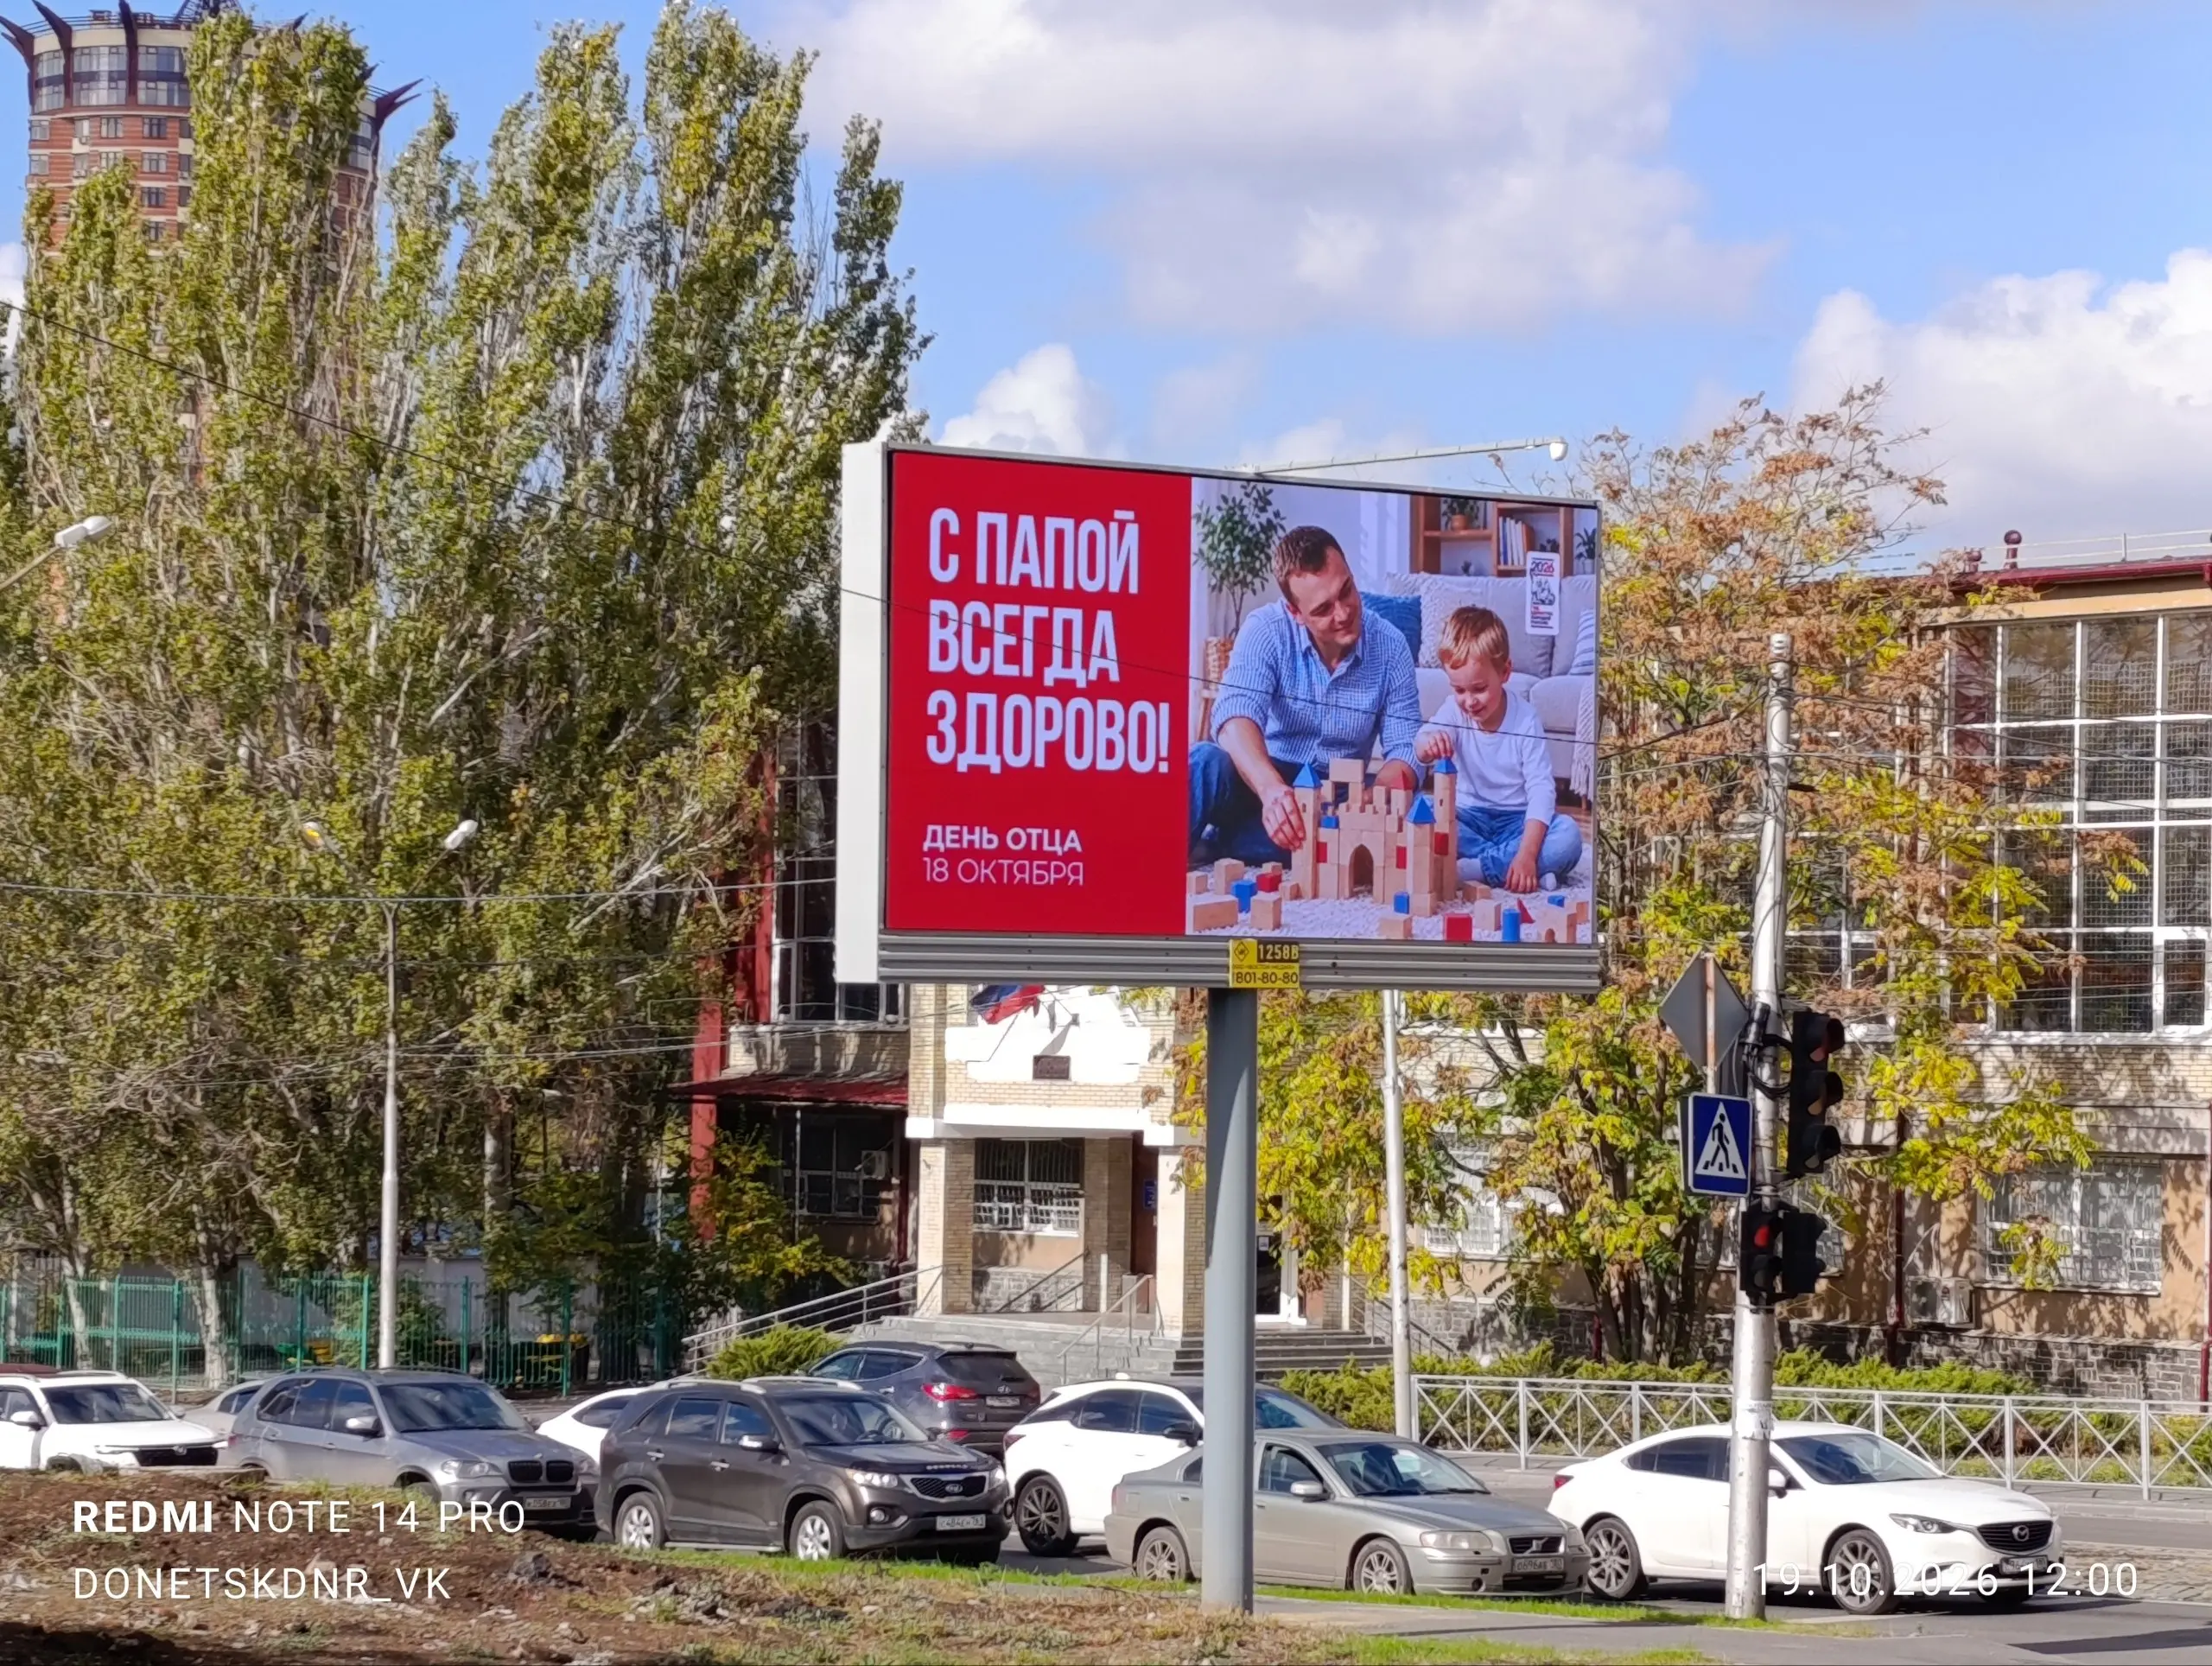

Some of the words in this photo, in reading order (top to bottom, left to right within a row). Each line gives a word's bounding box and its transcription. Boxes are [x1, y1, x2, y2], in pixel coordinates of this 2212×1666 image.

[929, 507, 960, 583] С
[976, 509, 1140, 594] ПАПОЙ
[928, 599, 1121, 688] ВСЕГДА
[926, 690, 1170, 774] ЗДОРОВО!
[923, 824, 1000, 853] ДЕНЬ
[1006, 827, 1083, 856] ОТЦА
[923, 857, 950, 882] 18
[957, 858, 1084, 886] ОКТЯБРЯ
[1235, 971, 1299, 984] 801-80-80
